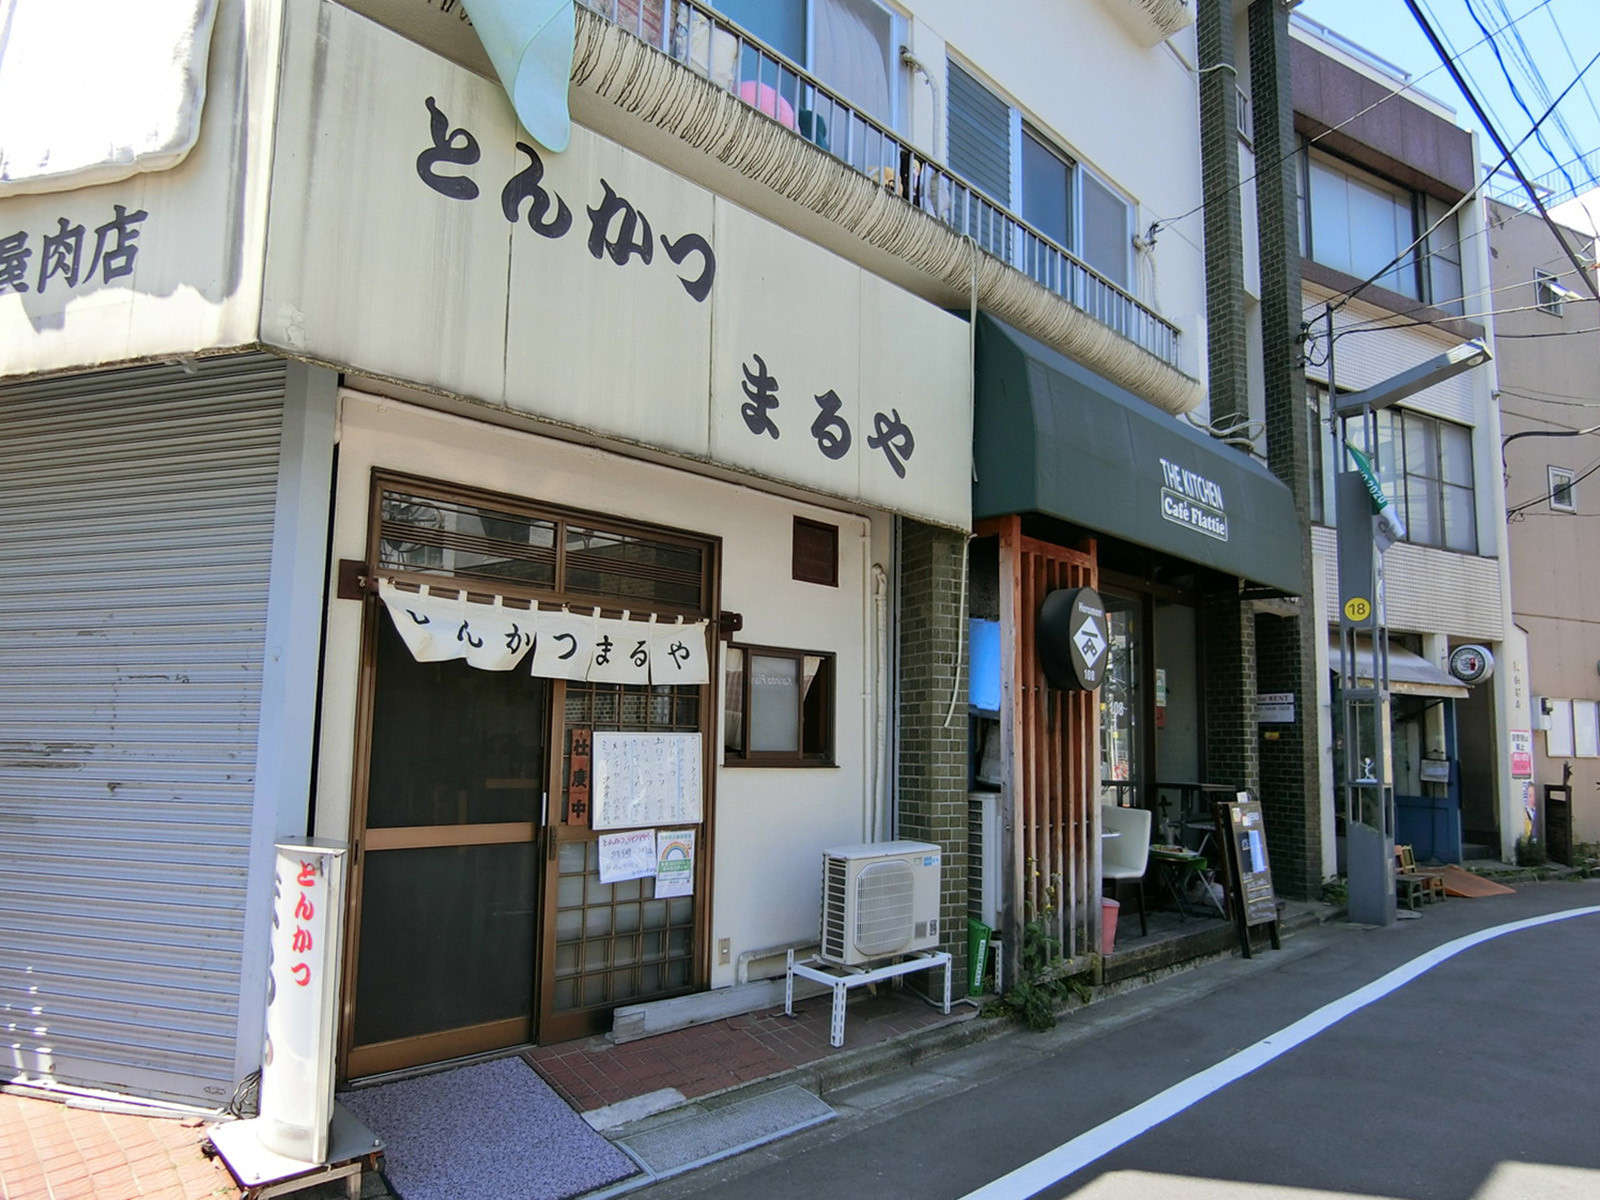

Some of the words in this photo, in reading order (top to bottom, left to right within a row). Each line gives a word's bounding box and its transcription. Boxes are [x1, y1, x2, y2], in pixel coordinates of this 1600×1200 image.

[416, 96, 716, 303] とんかつ
[741, 353, 915, 479] まるや
[1160, 458, 1184, 493] THE
[1181, 468, 1225, 511] KITCHEN
[1365, 480, 1387, 504] 2020
[1164, 497, 1190, 521] Café
[1191, 507, 1225, 535] Flattie
[1348, 603, 1366, 615] 18
[1083, 669, 1096, 681] 108
[290, 859, 317, 987] とんかつ
